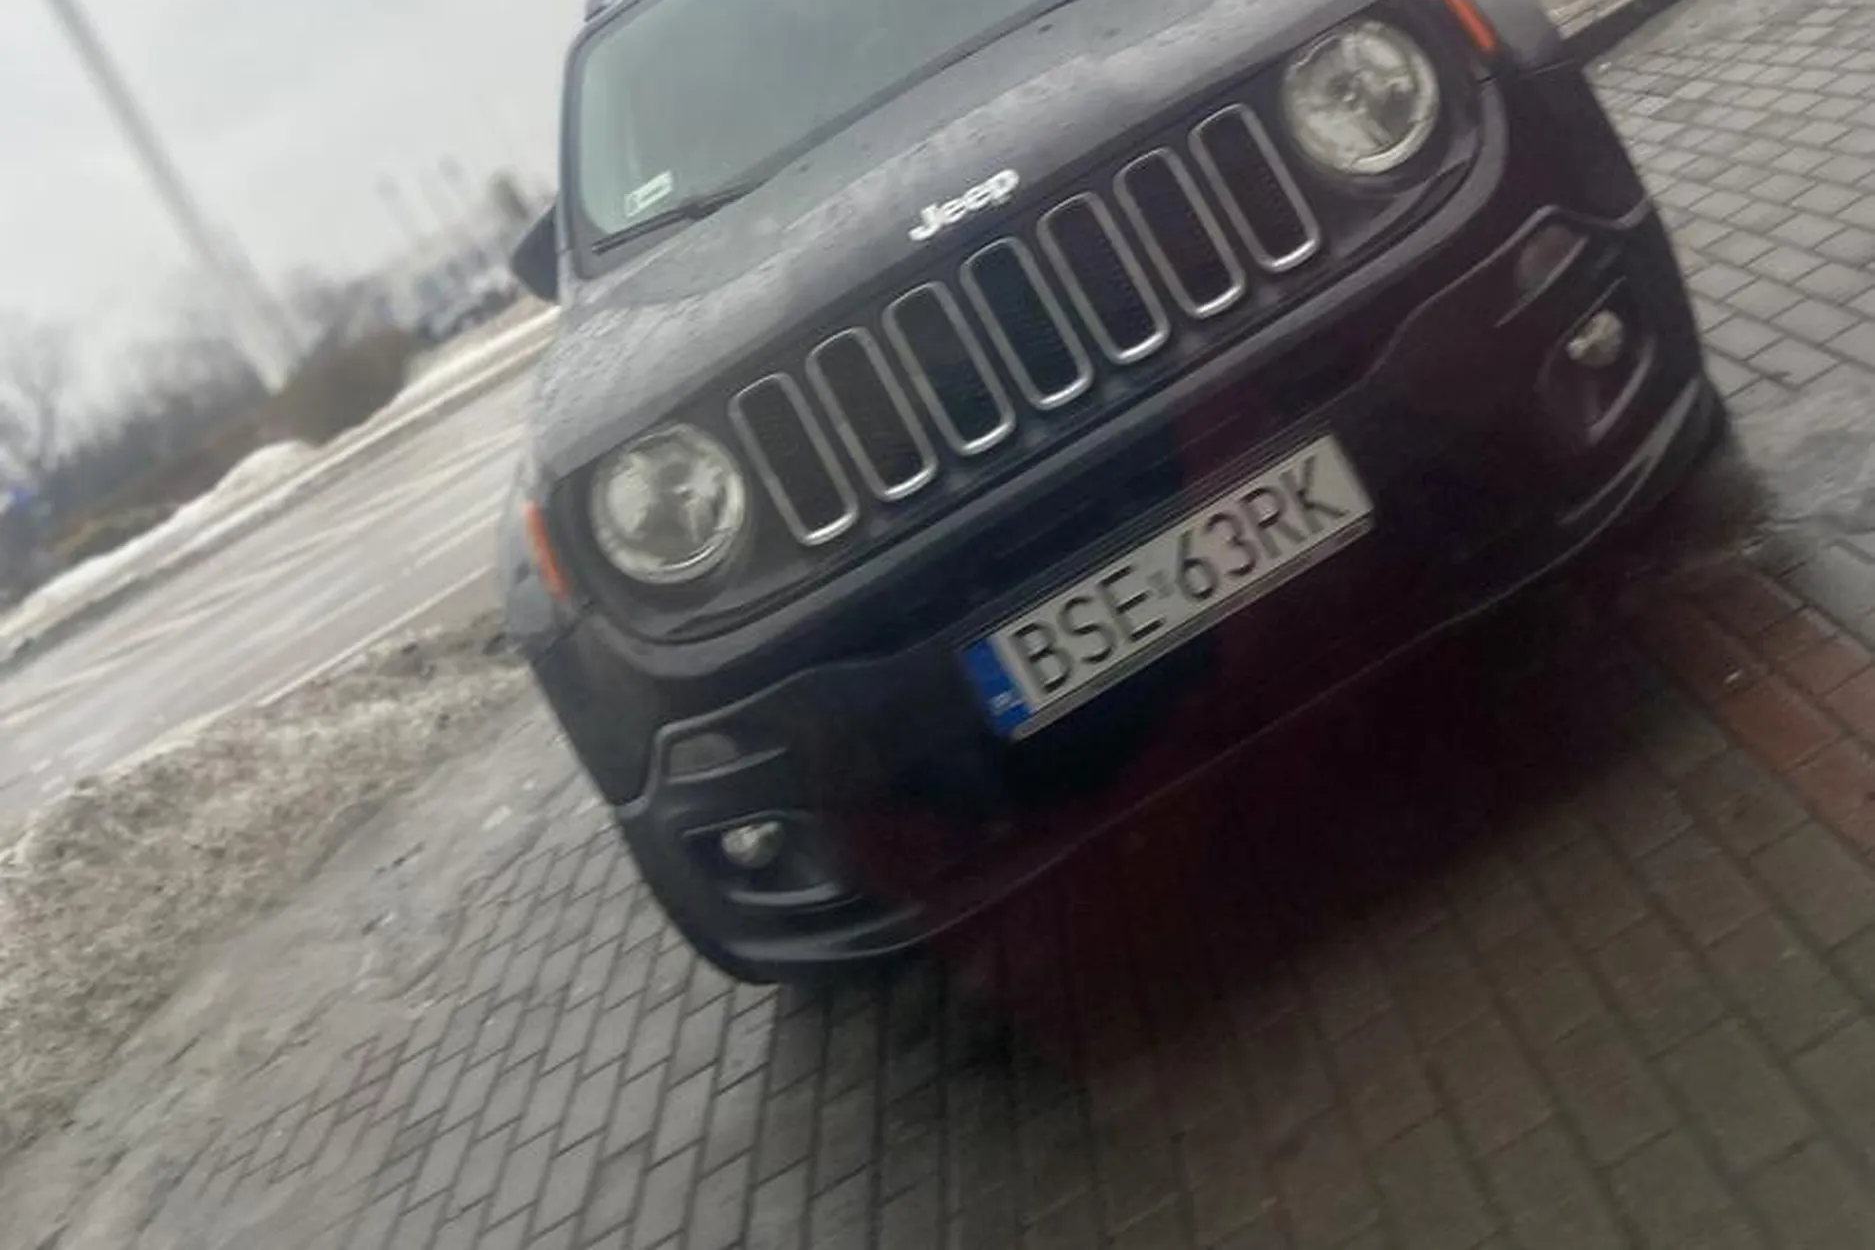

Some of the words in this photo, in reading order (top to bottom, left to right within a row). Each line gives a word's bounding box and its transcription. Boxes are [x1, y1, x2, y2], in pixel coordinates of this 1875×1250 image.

[908, 168, 1020, 241] Jeep
[1008, 565, 1165, 693] BSE
[1176, 455, 1350, 602] 63RK
